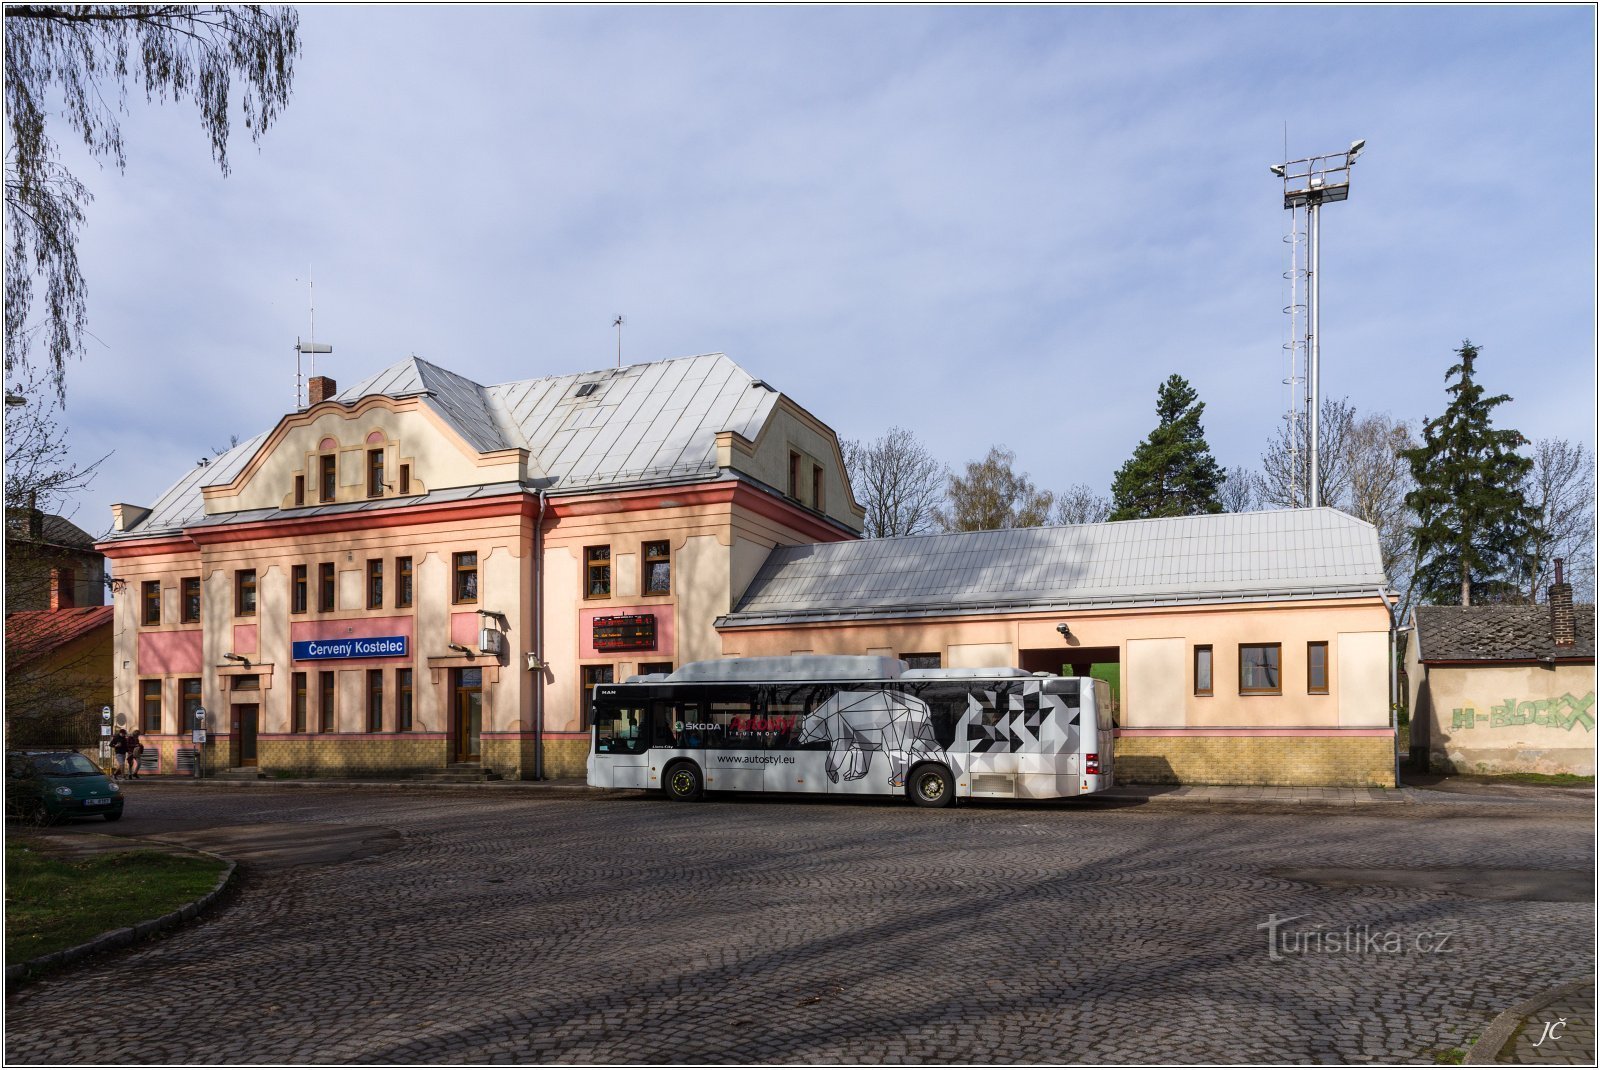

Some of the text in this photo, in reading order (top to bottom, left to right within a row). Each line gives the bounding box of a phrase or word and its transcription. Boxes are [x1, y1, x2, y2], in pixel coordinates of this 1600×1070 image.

[309, 640, 403, 657] Červený Kostelec
[685, 722, 721, 730] ŠKODA
[717, 755, 795, 766] www.autostyl.eu
